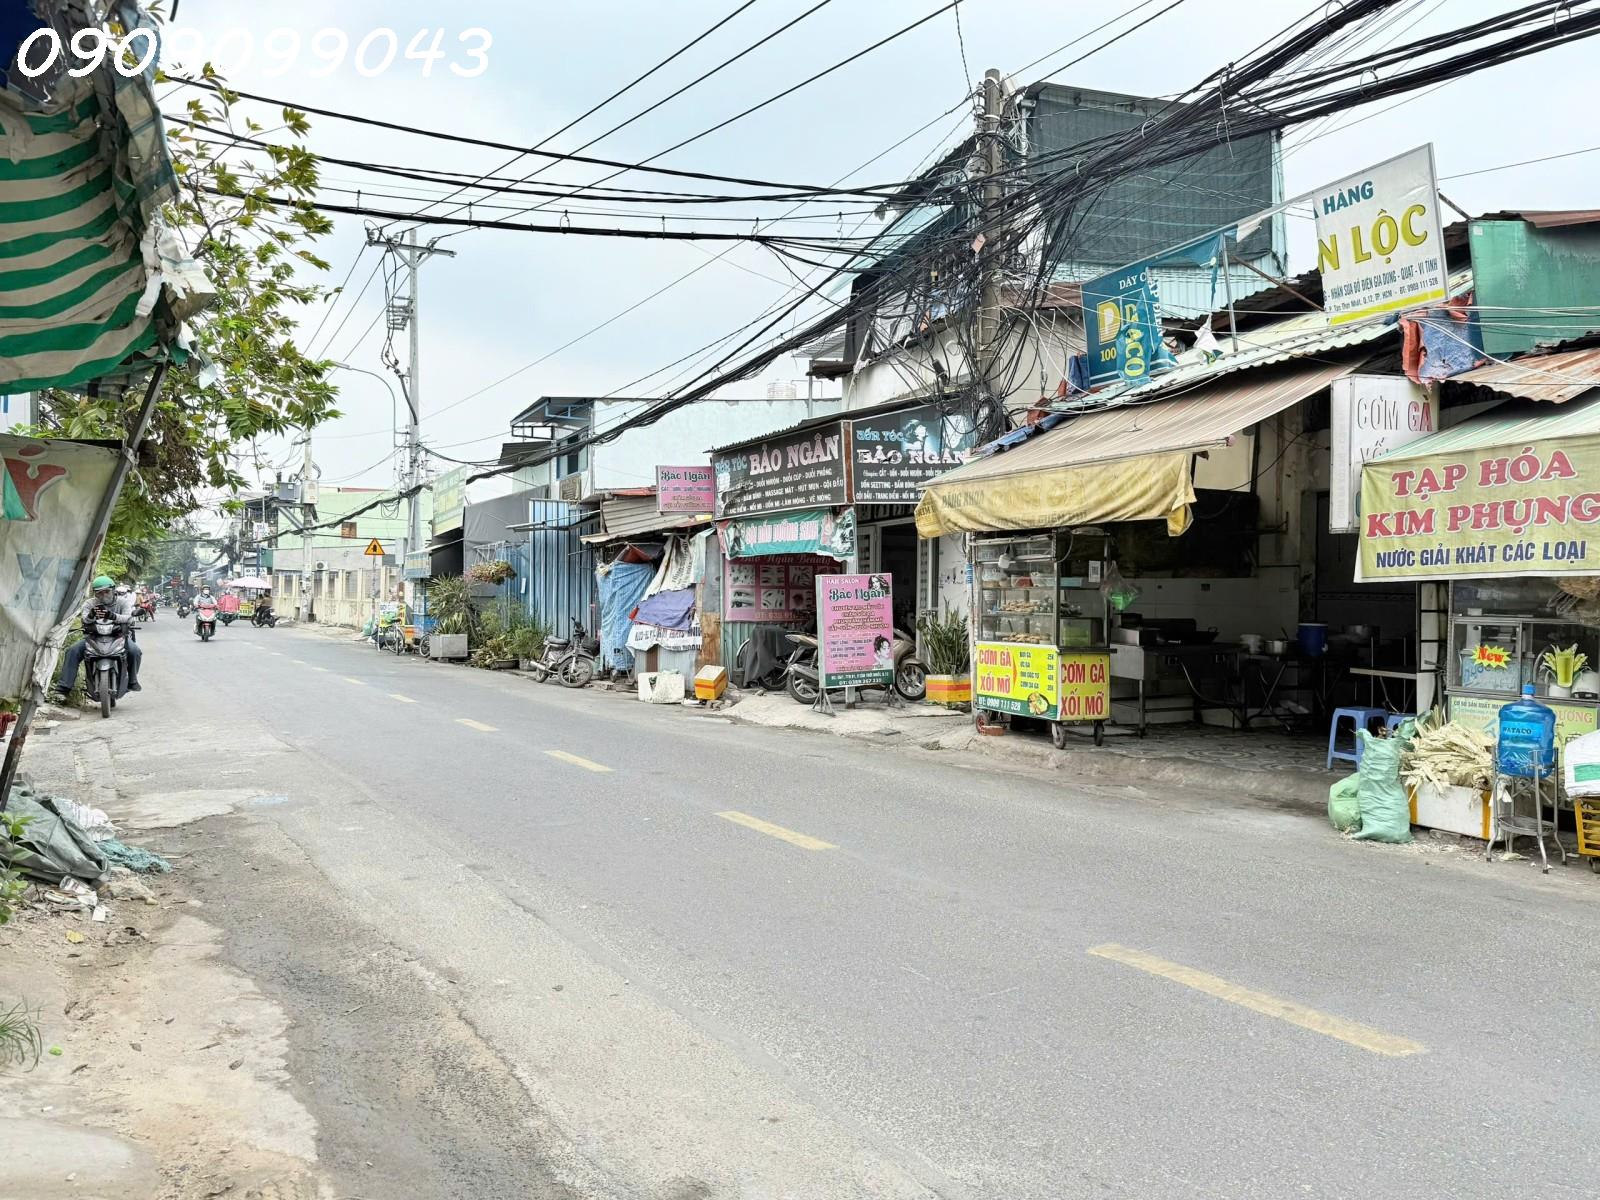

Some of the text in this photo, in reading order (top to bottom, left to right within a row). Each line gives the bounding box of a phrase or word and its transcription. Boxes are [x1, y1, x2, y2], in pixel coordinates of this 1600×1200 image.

[1323, 180, 1374, 215] HÀNG
[1350, 204, 1428, 264] LỘC
[1357, 394, 1433, 432] CƠM GÀ
[749, 432, 840, 476] BẢO NGÂN
[856, 445, 967, 464] BẢO NGÂN
[1391, 446, 1577, 501] TẠP HÓA
[1366, 492, 1600, 539] KIM PHỤNG
[1375, 540, 1587, 568] NƯỚC GIẢI KHÁT CÁC LOẠI
[979, 647, 1012, 667] CƠM GÀ
[1479, 647, 1505, 663] New
[980, 671, 1011, 694] XỐI MỠ
[1061, 658, 1106, 684] CƠM GÀ
[986, 697, 1000, 708] 0909
[1000, 700, 1010, 710] 111
[1061, 688, 1105, 716] XỐI MỠ
